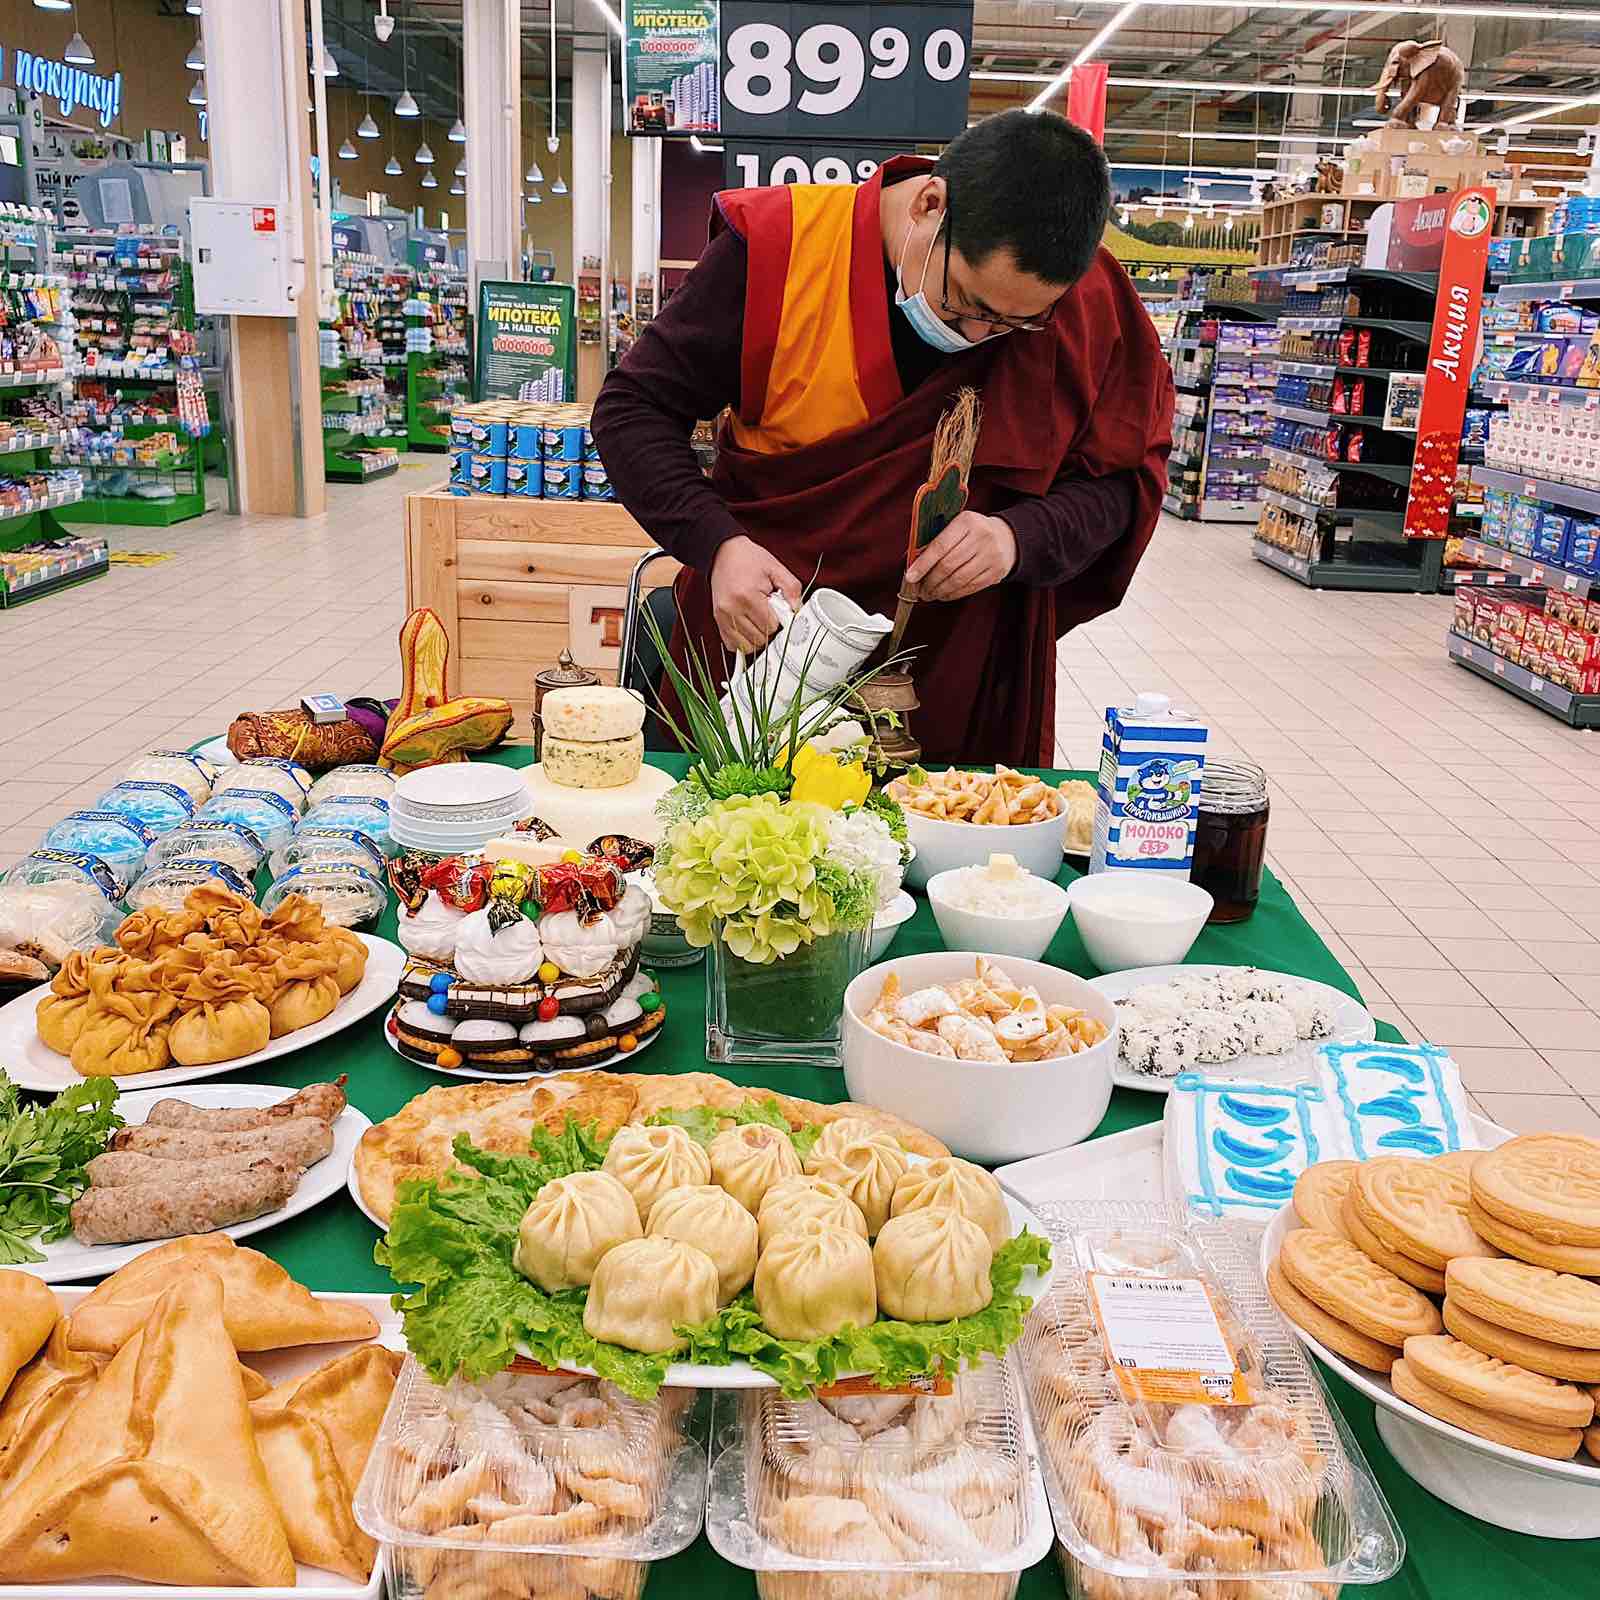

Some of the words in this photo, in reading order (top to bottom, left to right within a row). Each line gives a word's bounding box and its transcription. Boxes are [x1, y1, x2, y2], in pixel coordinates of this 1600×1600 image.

[633, 15, 710, 28] ИПОТЕКА
[723, 23, 865, 115] 89
[16, 49, 121, 128] покупку!
[488, 307, 561, 326] ИПОТЕКА
[498, 322, 510, 331] ЗА
[512, 322, 533, 333] НАШ
[1431, 285, 1471, 382] Акция
[1126, 802, 1187, 821] ПРОСТОКВАШИНО
[1125, 825, 1184, 839] МОЛОКО
